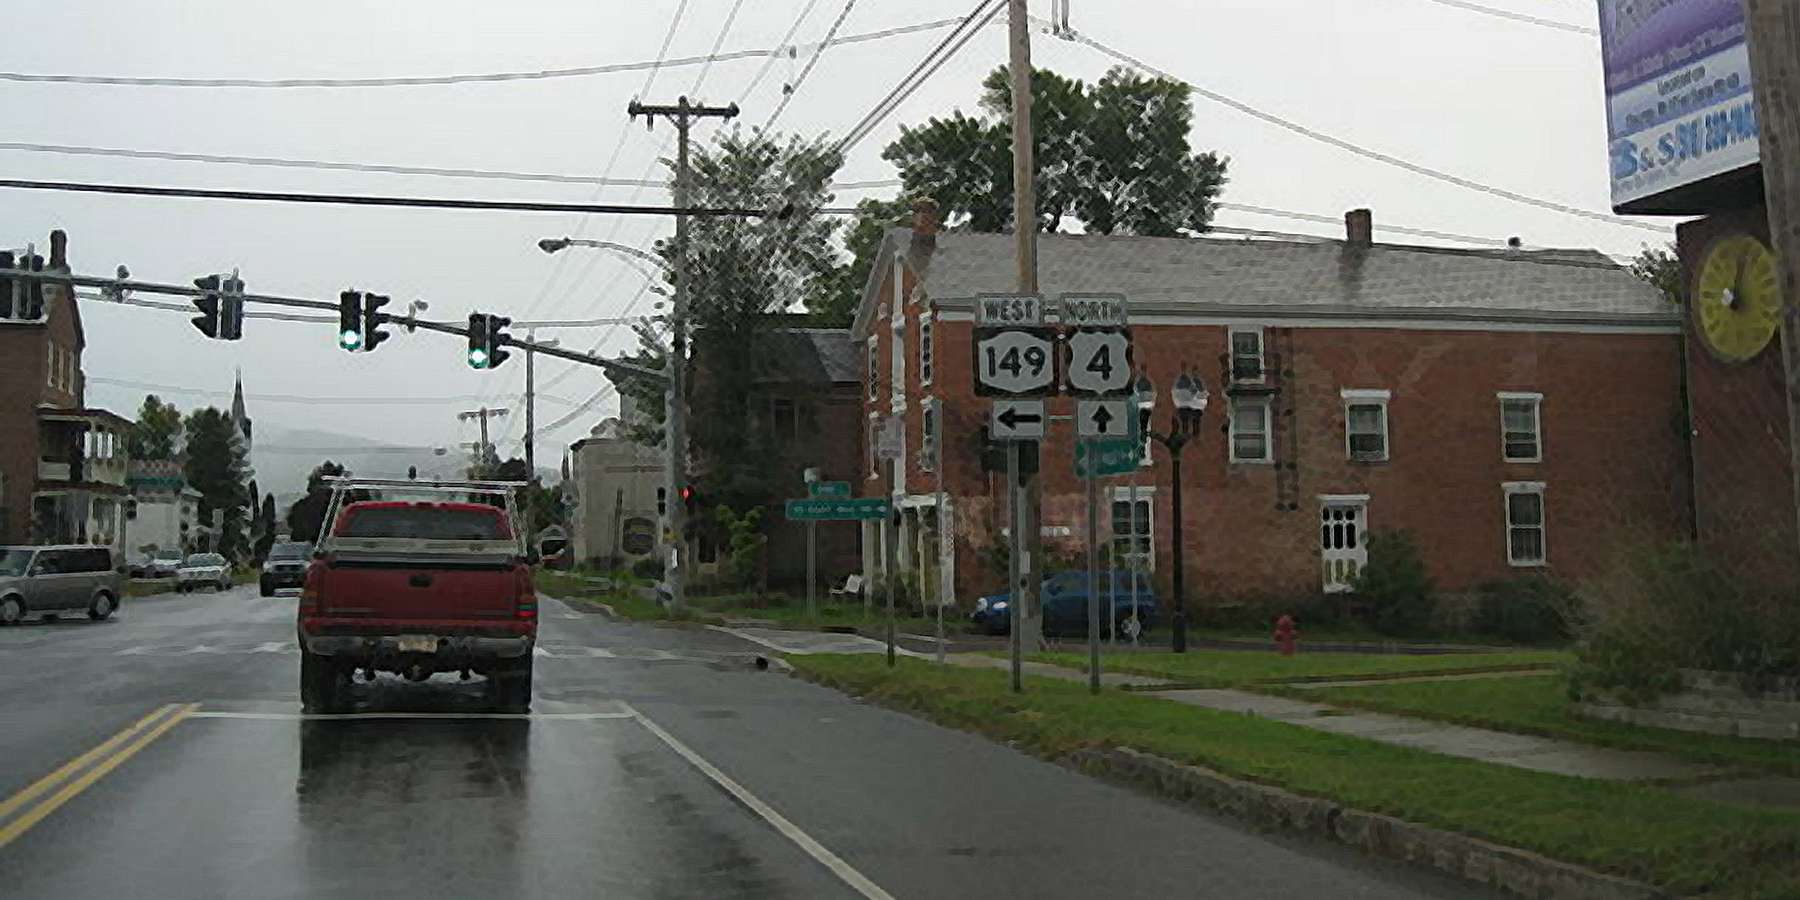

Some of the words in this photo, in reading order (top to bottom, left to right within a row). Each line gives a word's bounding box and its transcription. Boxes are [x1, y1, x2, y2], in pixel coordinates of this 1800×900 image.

[984, 299, 1034, 322] WEST
[1065, 299, 1123, 322] NORTH
[986, 346, 1046, 378] 149
[1085, 343, 1113, 381] 4
